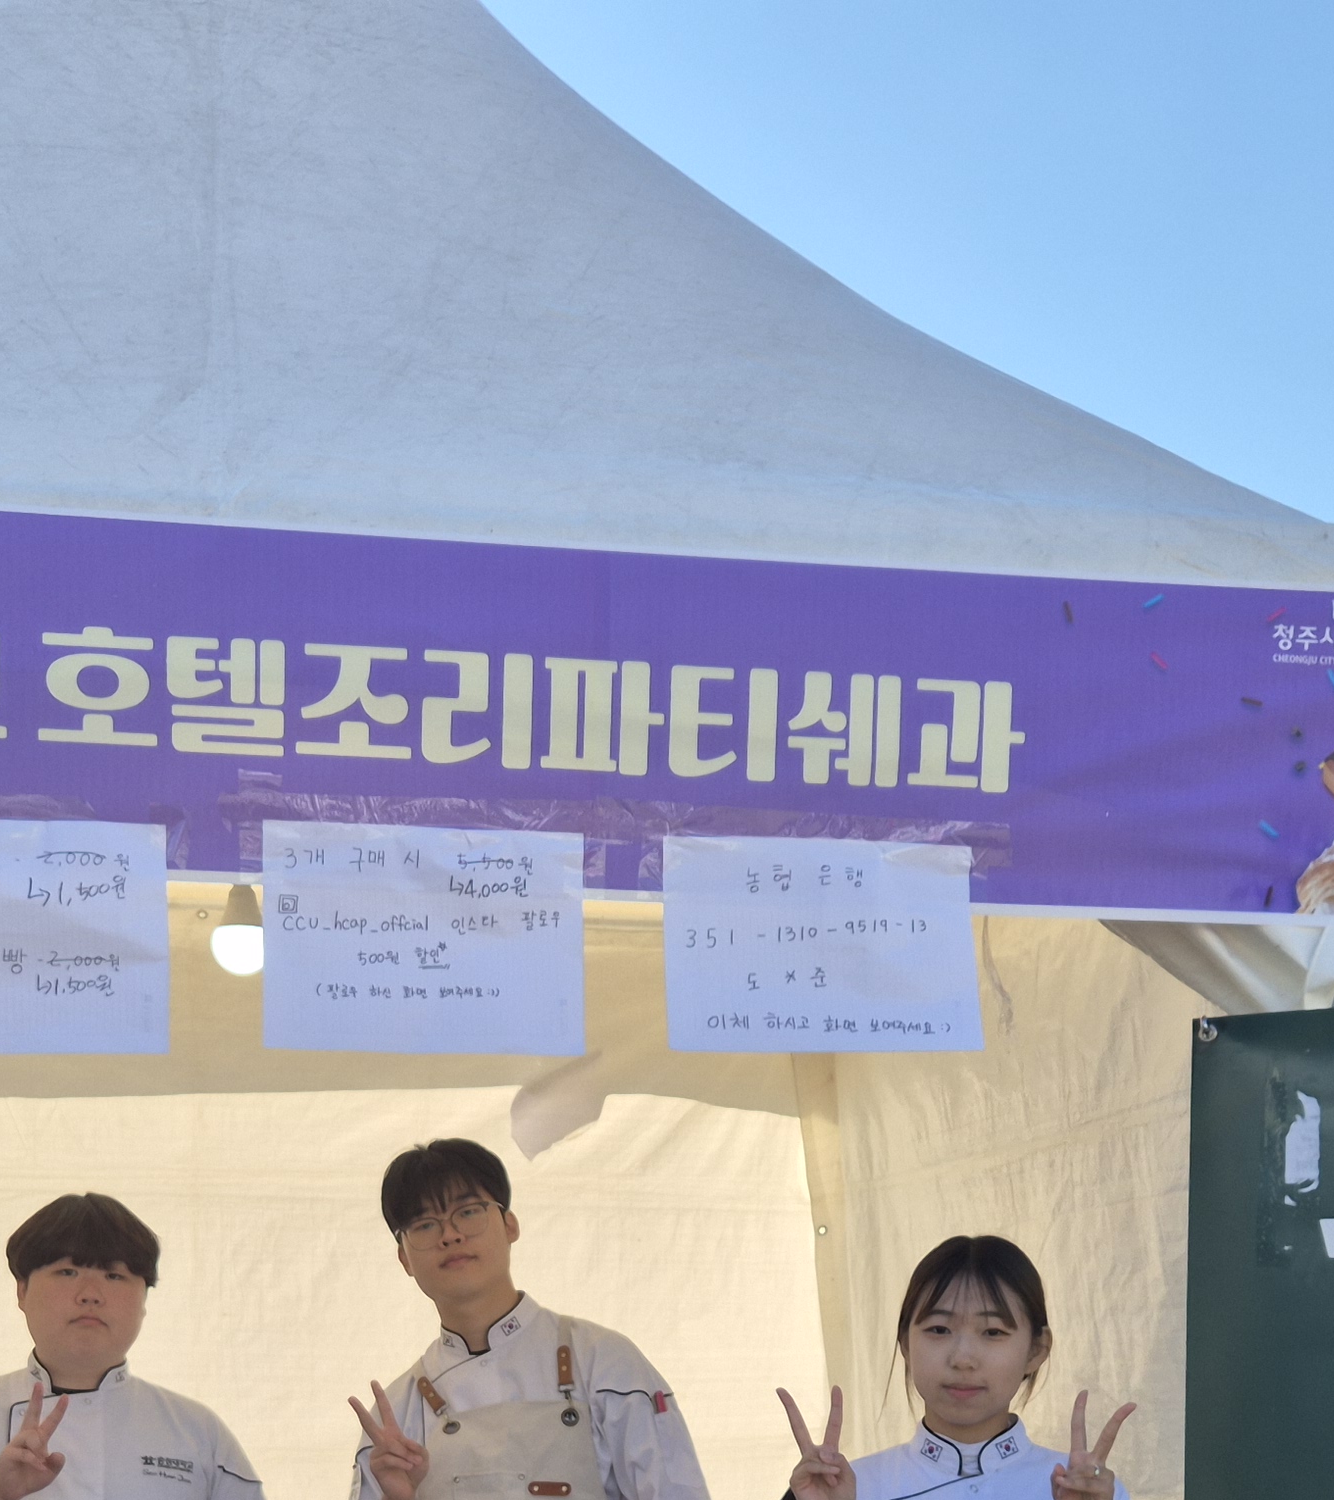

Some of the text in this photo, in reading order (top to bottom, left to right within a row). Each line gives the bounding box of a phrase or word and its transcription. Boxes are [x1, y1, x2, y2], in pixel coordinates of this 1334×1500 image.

[1272, 653, 1318, 665] CHEONGJU
[37, 626, 1025, 793] 호텔조리파티쉐과
[284, 847, 326, 868] 3개
[348, 847, 386, 872] 구매
[403, 849, 420, 869] 시
[59, 875, 127, 907] 1,500원
[464, 876, 529, 899] 4,000원
[451, 914, 499, 936] 인스타
[521, 910, 561, 931] 팔로우
[357, 946, 440, 966] 500원 할인
[369, 984, 393, 999] 하신
[403, 984, 428, 999] 화면
[708, 1013, 750, 1030] 이체
[764, 1012, 810, 1030] 하시고
[823, 1014, 859, 1034] 화면
